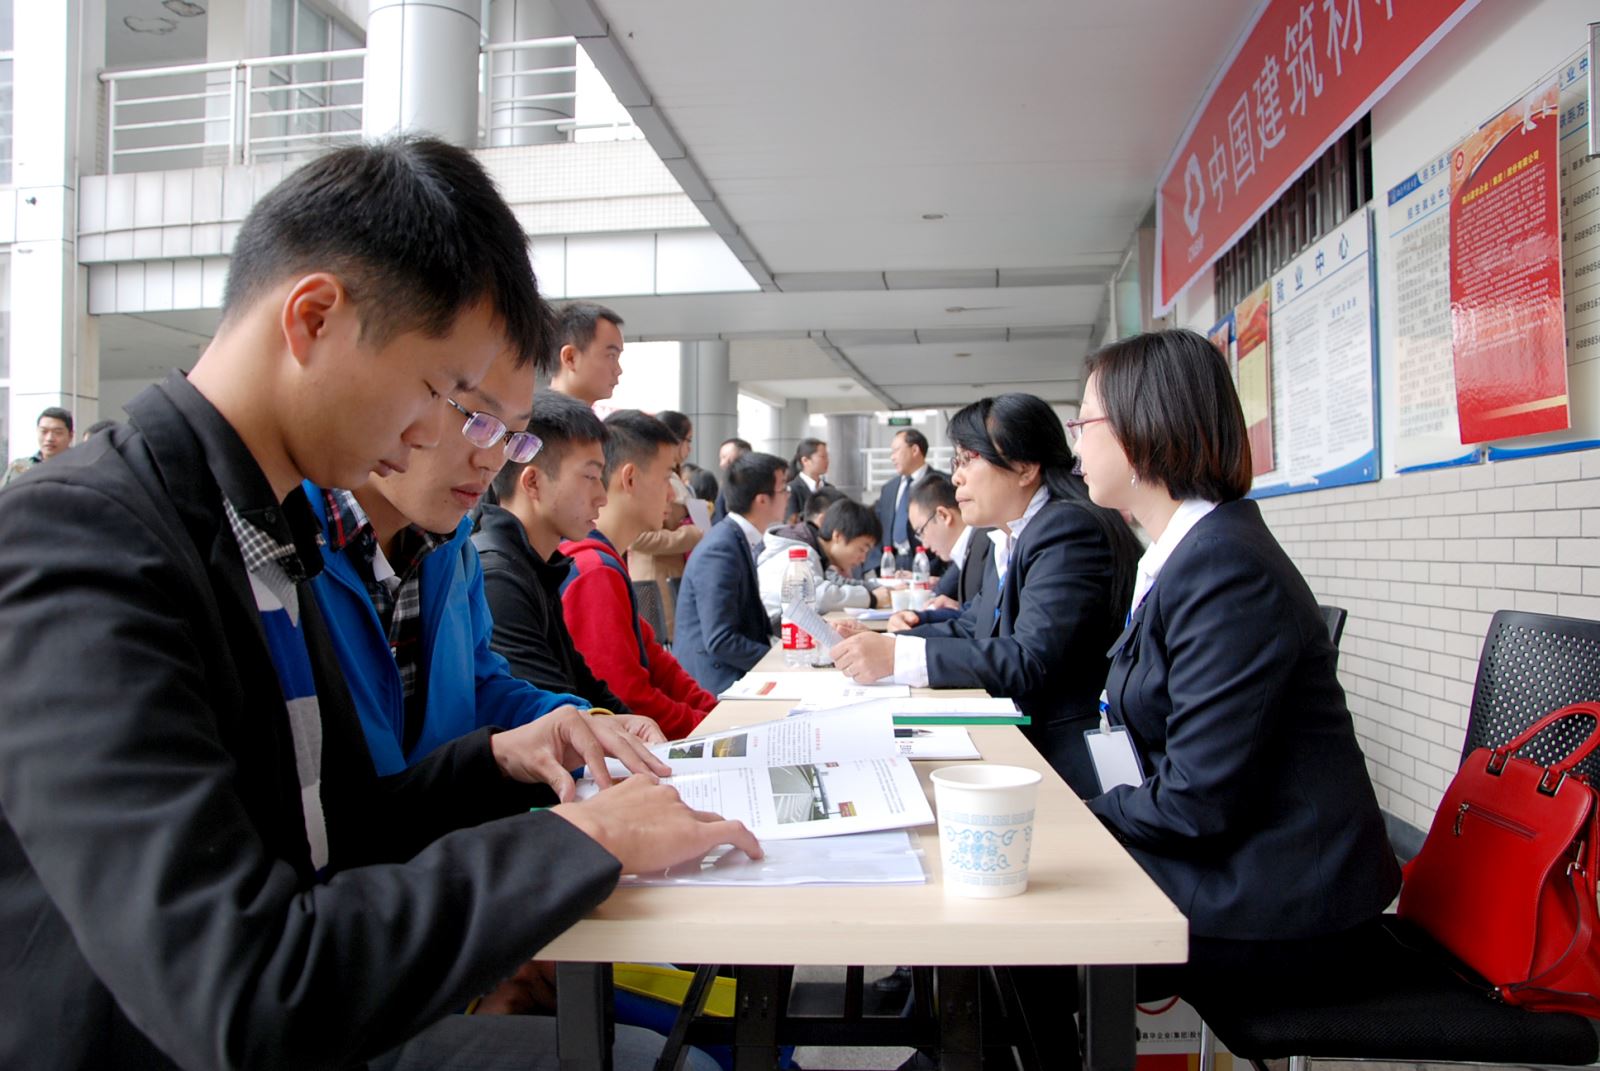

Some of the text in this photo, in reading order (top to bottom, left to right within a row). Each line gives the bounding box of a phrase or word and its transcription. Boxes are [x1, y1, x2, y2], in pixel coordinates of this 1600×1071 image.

[1208, 0, 1394, 213] 中国建筑材
